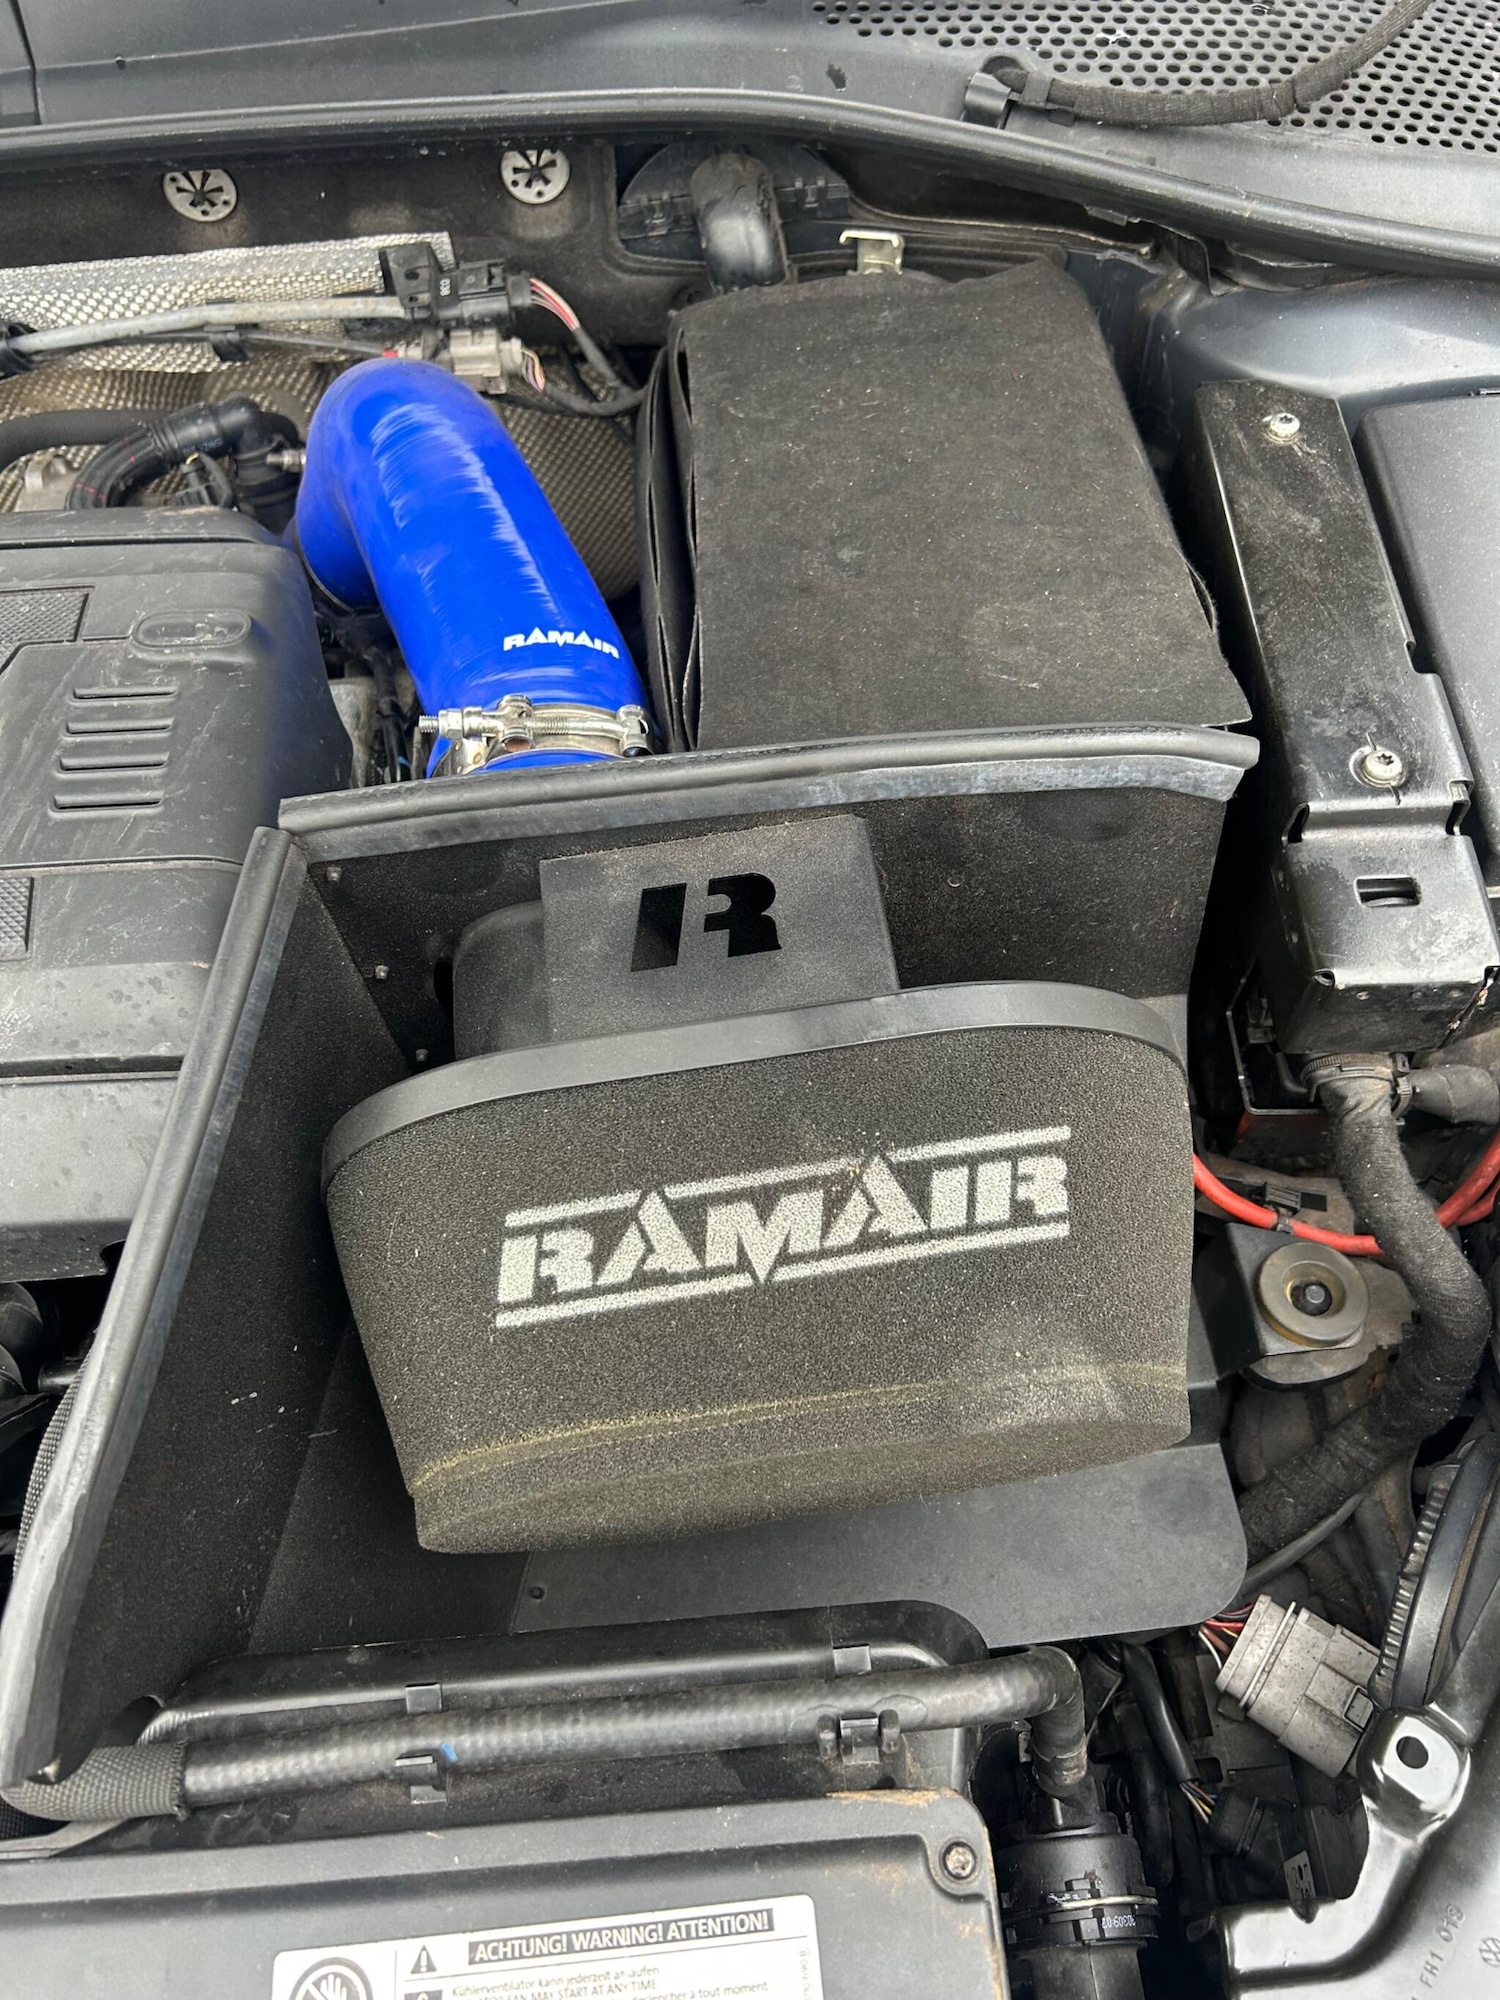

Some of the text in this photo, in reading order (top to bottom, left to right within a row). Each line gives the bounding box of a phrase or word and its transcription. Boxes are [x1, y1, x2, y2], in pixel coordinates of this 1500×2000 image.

[503, 626, 620, 659] RAMAIR
[497, 1152, 1070, 1303] RAMAIR
[474, 1910, 769, 1962] ACHTUNG! WARNING! ATTENTION!
[538, 1976, 564, 1988] kann
[566, 1970, 611, 1988] jederzeit
[558, 1985, 588, 2000] START
[591, 1984, 604, 1996] AT
[606, 1982, 629, 1994] ANY
[631, 1978, 657, 1991] TIME
[698, 1987, 720, 1998] tout
[723, 1981, 769, 1995] moment
